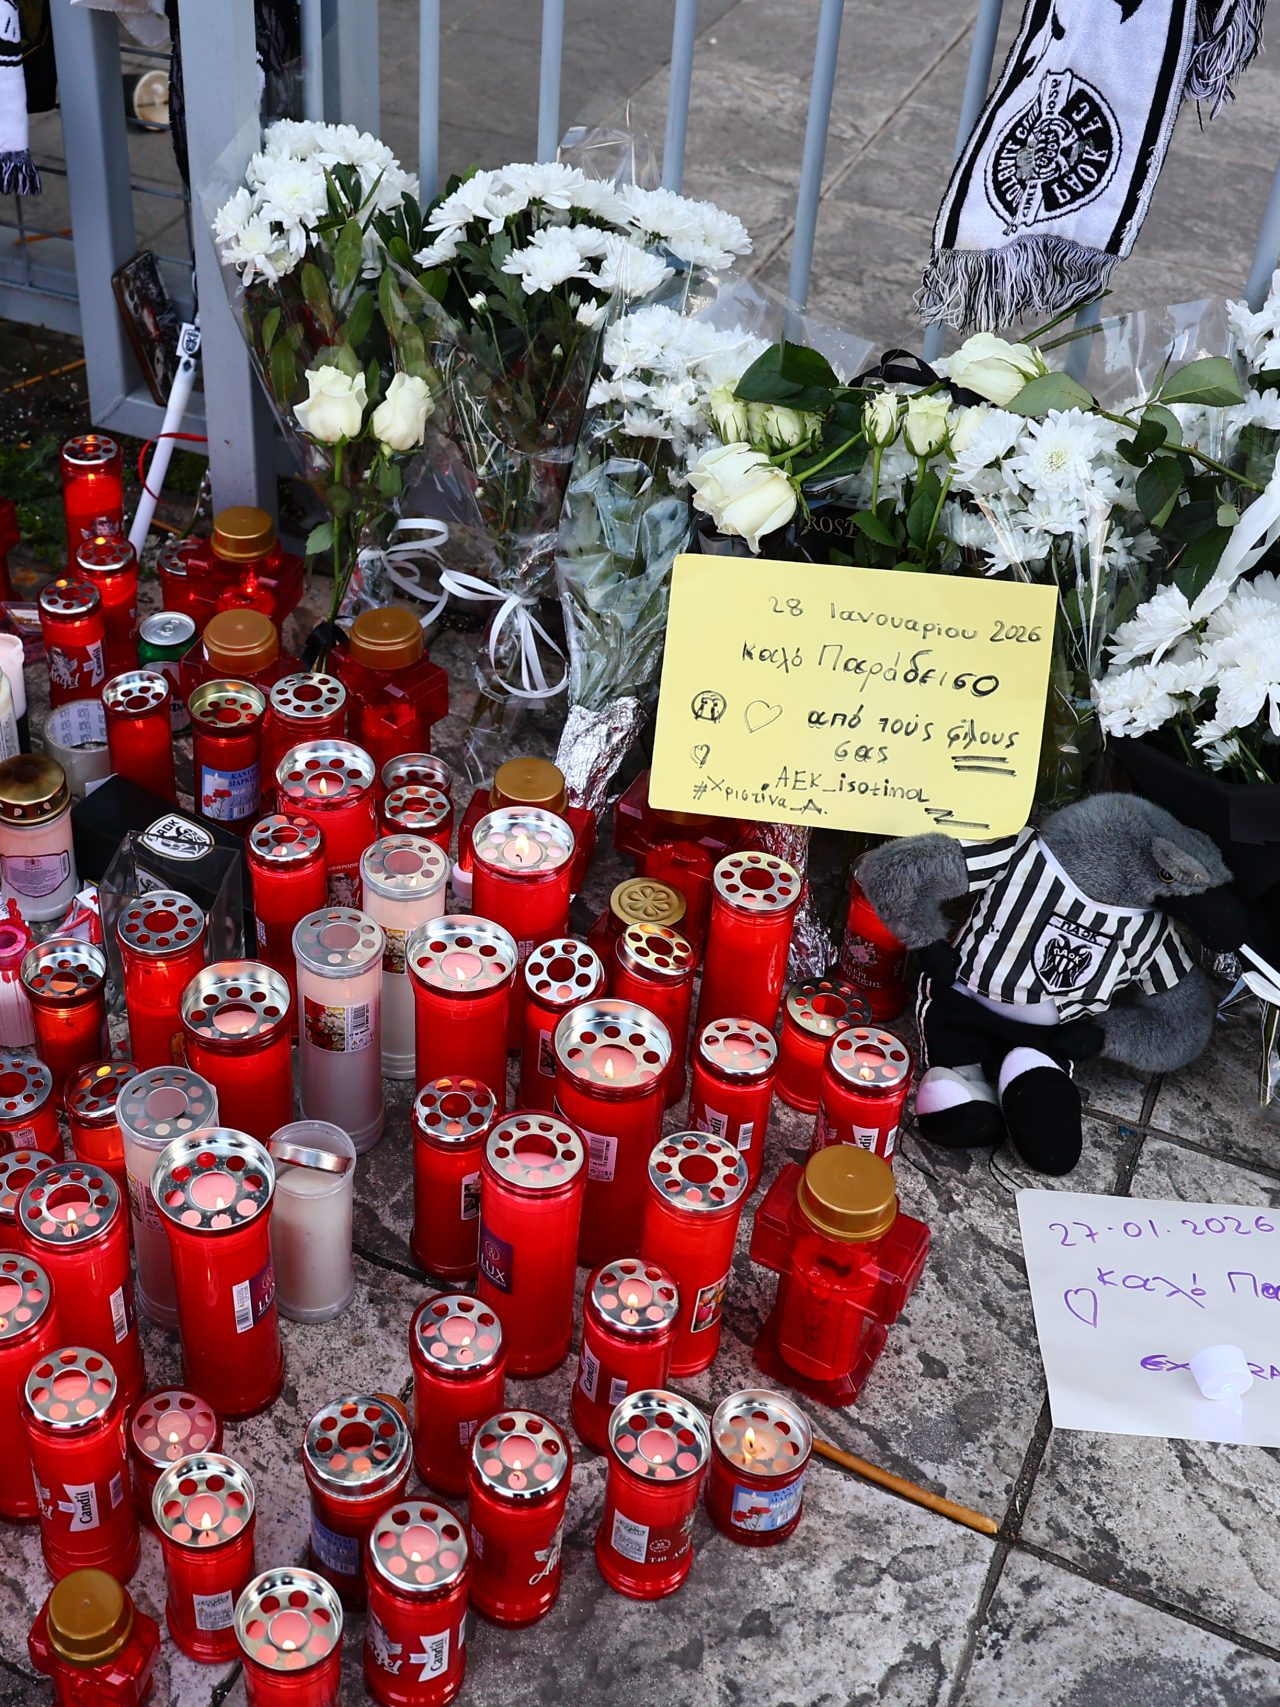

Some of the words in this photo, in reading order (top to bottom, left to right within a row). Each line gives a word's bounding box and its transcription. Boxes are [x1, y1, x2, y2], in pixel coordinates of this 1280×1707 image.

[768, 596, 804, 616] 28
[989, 620, 1043, 643] 2026
[807, 703, 865, 730] από
[1060, 920, 1099, 944] ΠΑΟΚ
[1053, 948, 1083, 965] ΠΑΟΚ
